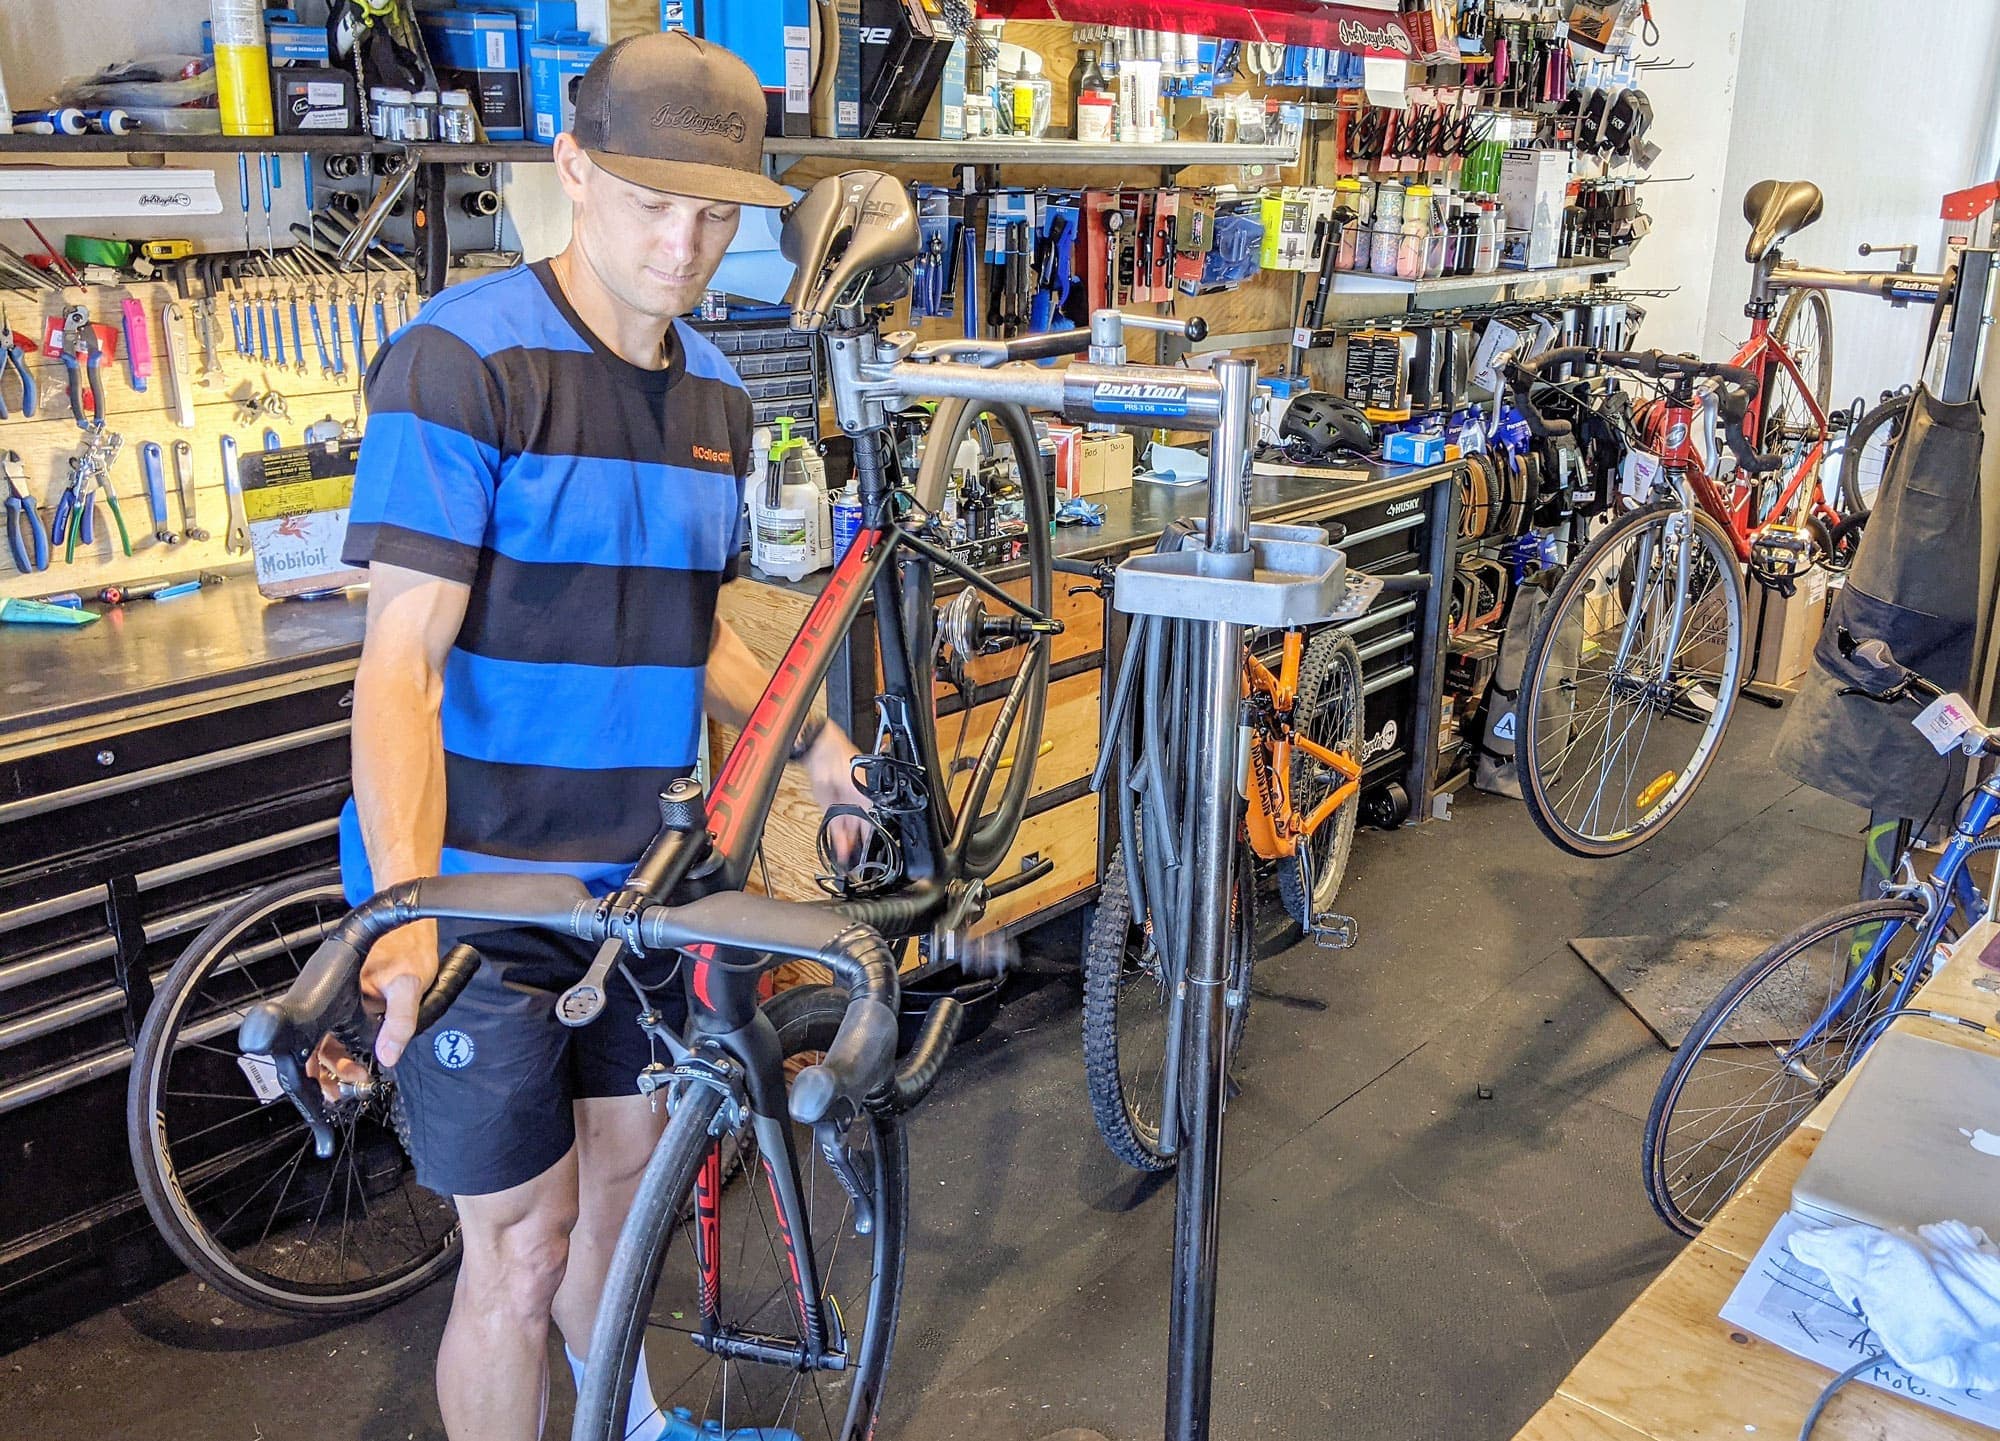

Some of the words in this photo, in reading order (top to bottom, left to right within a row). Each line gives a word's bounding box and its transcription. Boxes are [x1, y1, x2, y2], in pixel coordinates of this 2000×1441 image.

[1395, 497, 1420, 515] HUSKY
[261, 547, 328, 574] Mobiloil
[1252, 744, 1272, 818] MOUNTAIN
